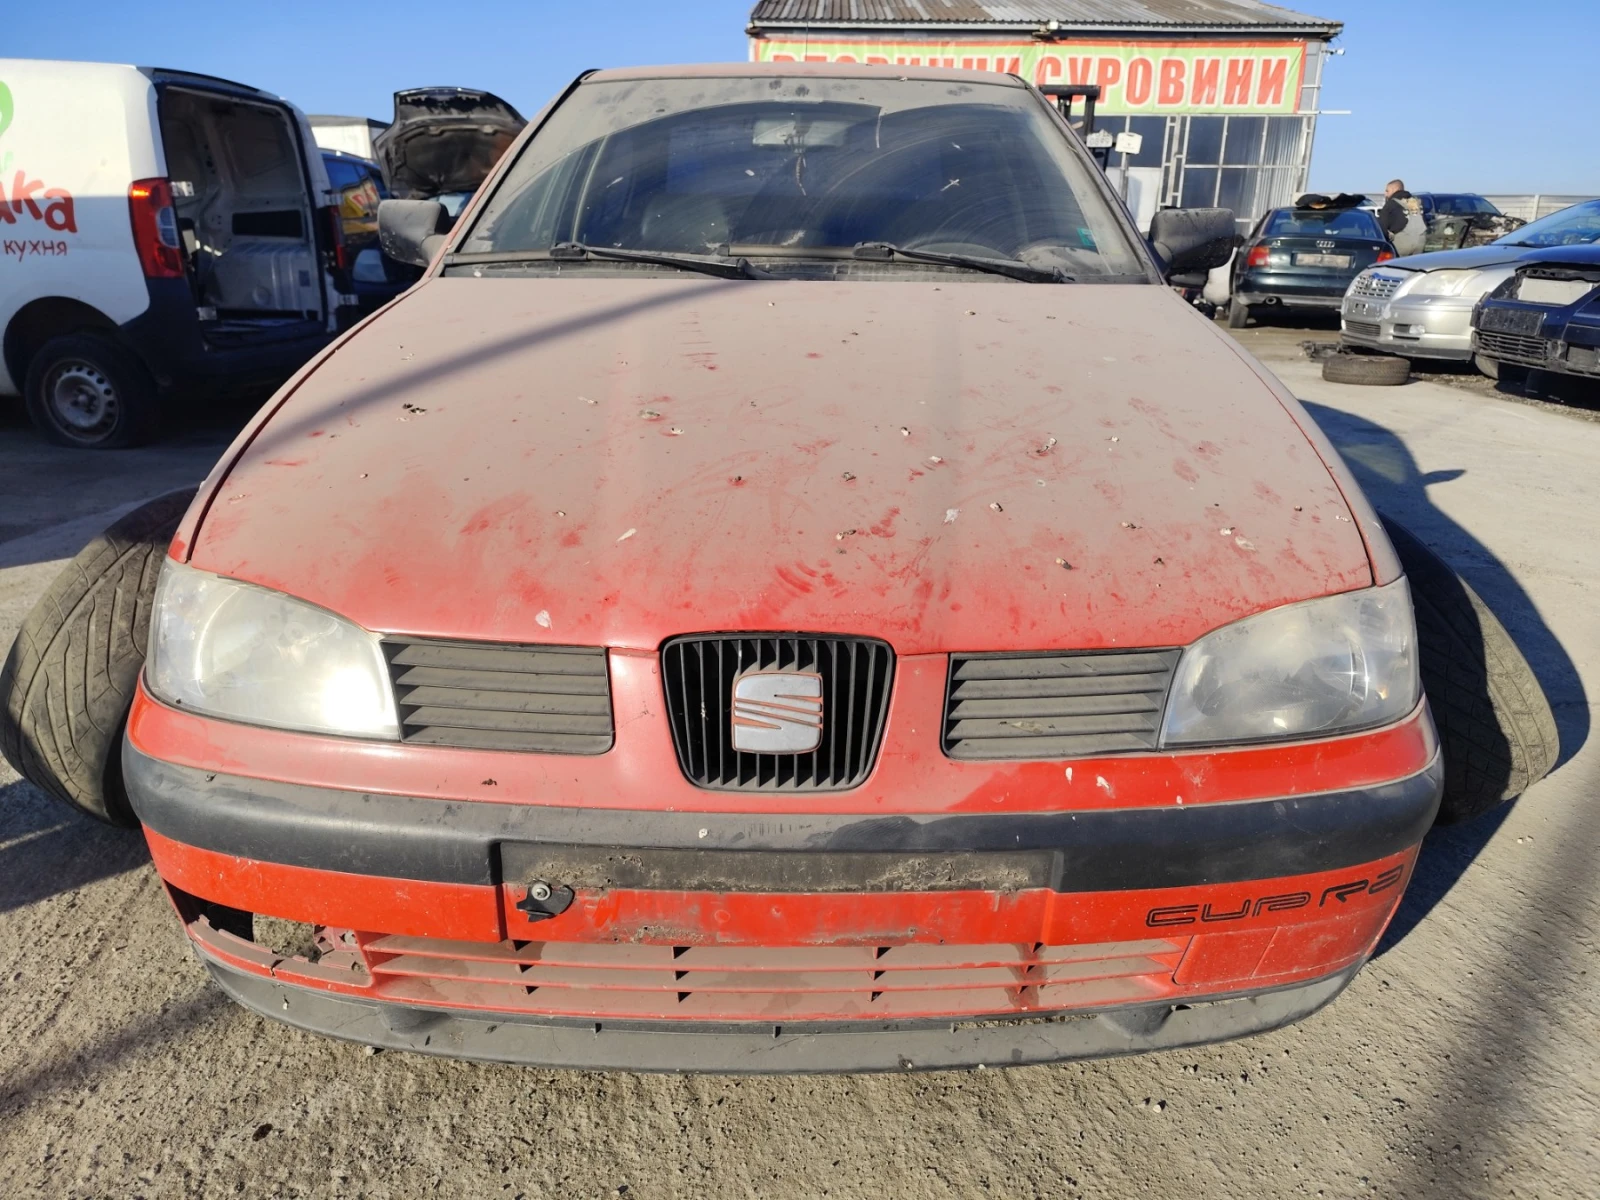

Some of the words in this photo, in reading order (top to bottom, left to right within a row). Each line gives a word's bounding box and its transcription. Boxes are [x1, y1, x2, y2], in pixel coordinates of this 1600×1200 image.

[1036, 56, 1288, 105] СУРОВИНИ
[3, 239, 68, 262] кухня
[1146, 864, 1404, 927] CUPRA
